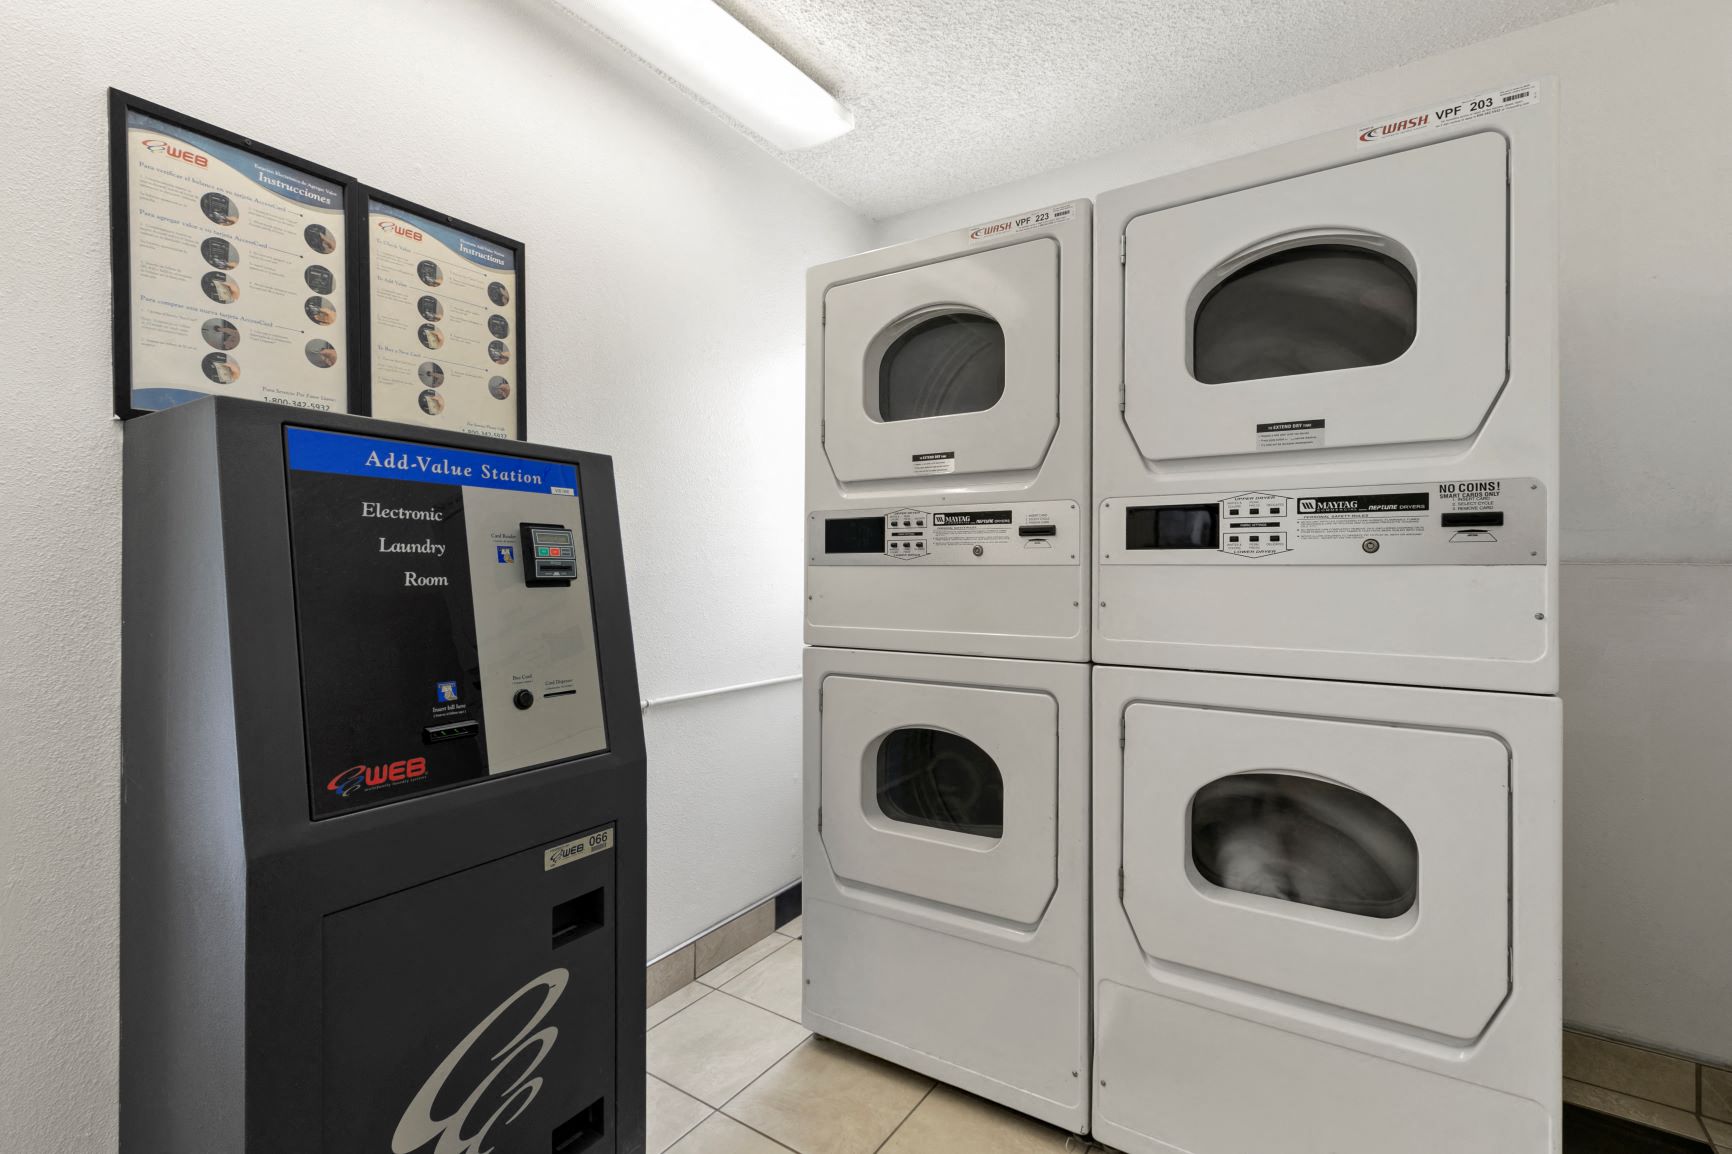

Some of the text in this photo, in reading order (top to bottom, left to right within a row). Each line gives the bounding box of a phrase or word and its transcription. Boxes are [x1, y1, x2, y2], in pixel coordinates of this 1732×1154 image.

[1382, 114, 1428, 135] WASH
[1436, 106, 1462, 120] VPF
[1470, 98, 1492, 112] 203
[139, 161, 154, 171] Para
[166, 147, 208, 168] WEB
[258, 172, 331, 204] Instrucciones
[139, 209, 154, 218] Para
[984, 222, 1011, 235] WASH
[1015, 217, 1030, 226] VPF
[1035, 213, 1049, 222] 223
[394, 228, 423, 242] WEB
[460, 243, 504, 266] Instructions
[140, 295, 156, 303] Para
[365, 451, 542, 485] Add-Value Station
[1440, 482, 1500, 493] NO COINS!
[362, 502, 442, 522] Electronic
[1317, 501, 1358, 509] MAYTAG
[379, 537, 446, 557] Laundry
[404, 572, 448, 586] Room
[365, 757, 426, 786] WEB
[562, 832, 607, 857] WEB 066
